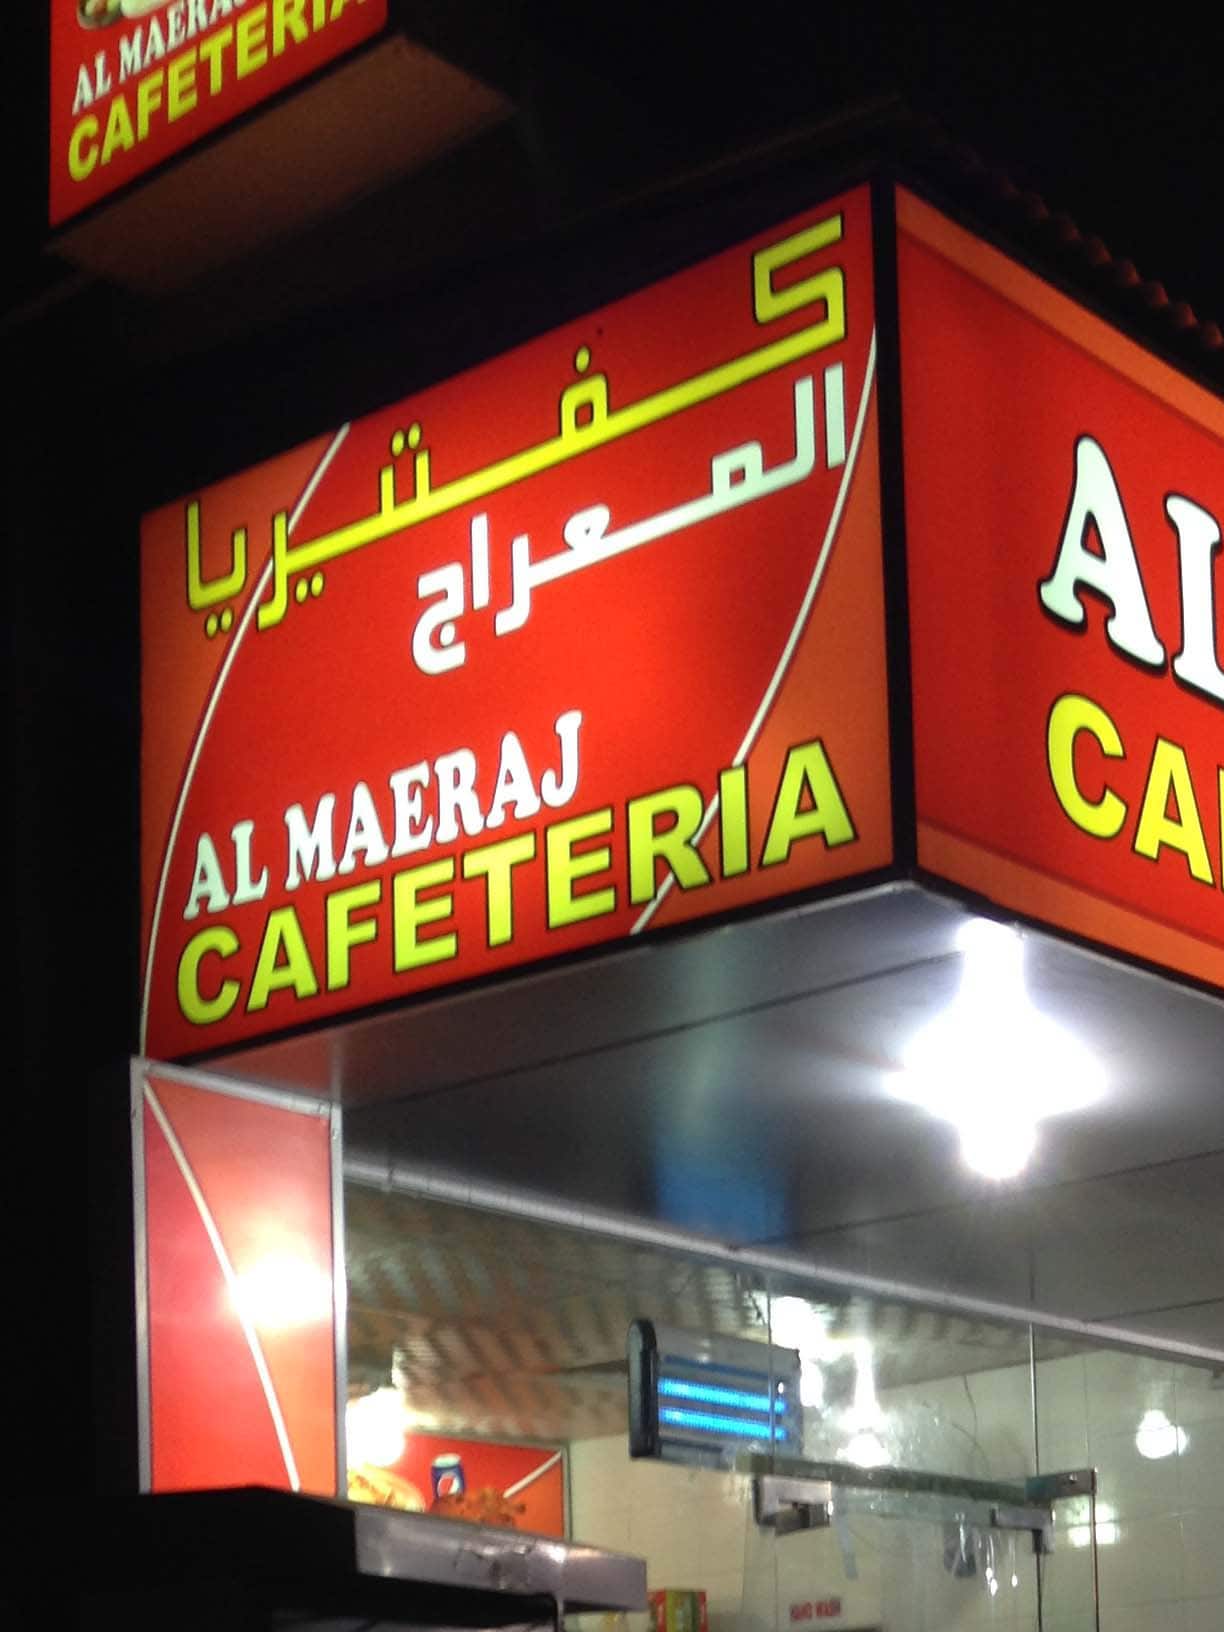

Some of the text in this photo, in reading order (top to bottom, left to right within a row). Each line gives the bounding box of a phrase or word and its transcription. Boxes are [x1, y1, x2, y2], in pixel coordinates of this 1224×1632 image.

[71, 0, 247, 116] AL MAER
[411, 361, 847, 676] المعراج
[176, 736, 857, 1026] CAFETERIA
[184, 709, 584, 920] AL MAERAJ
